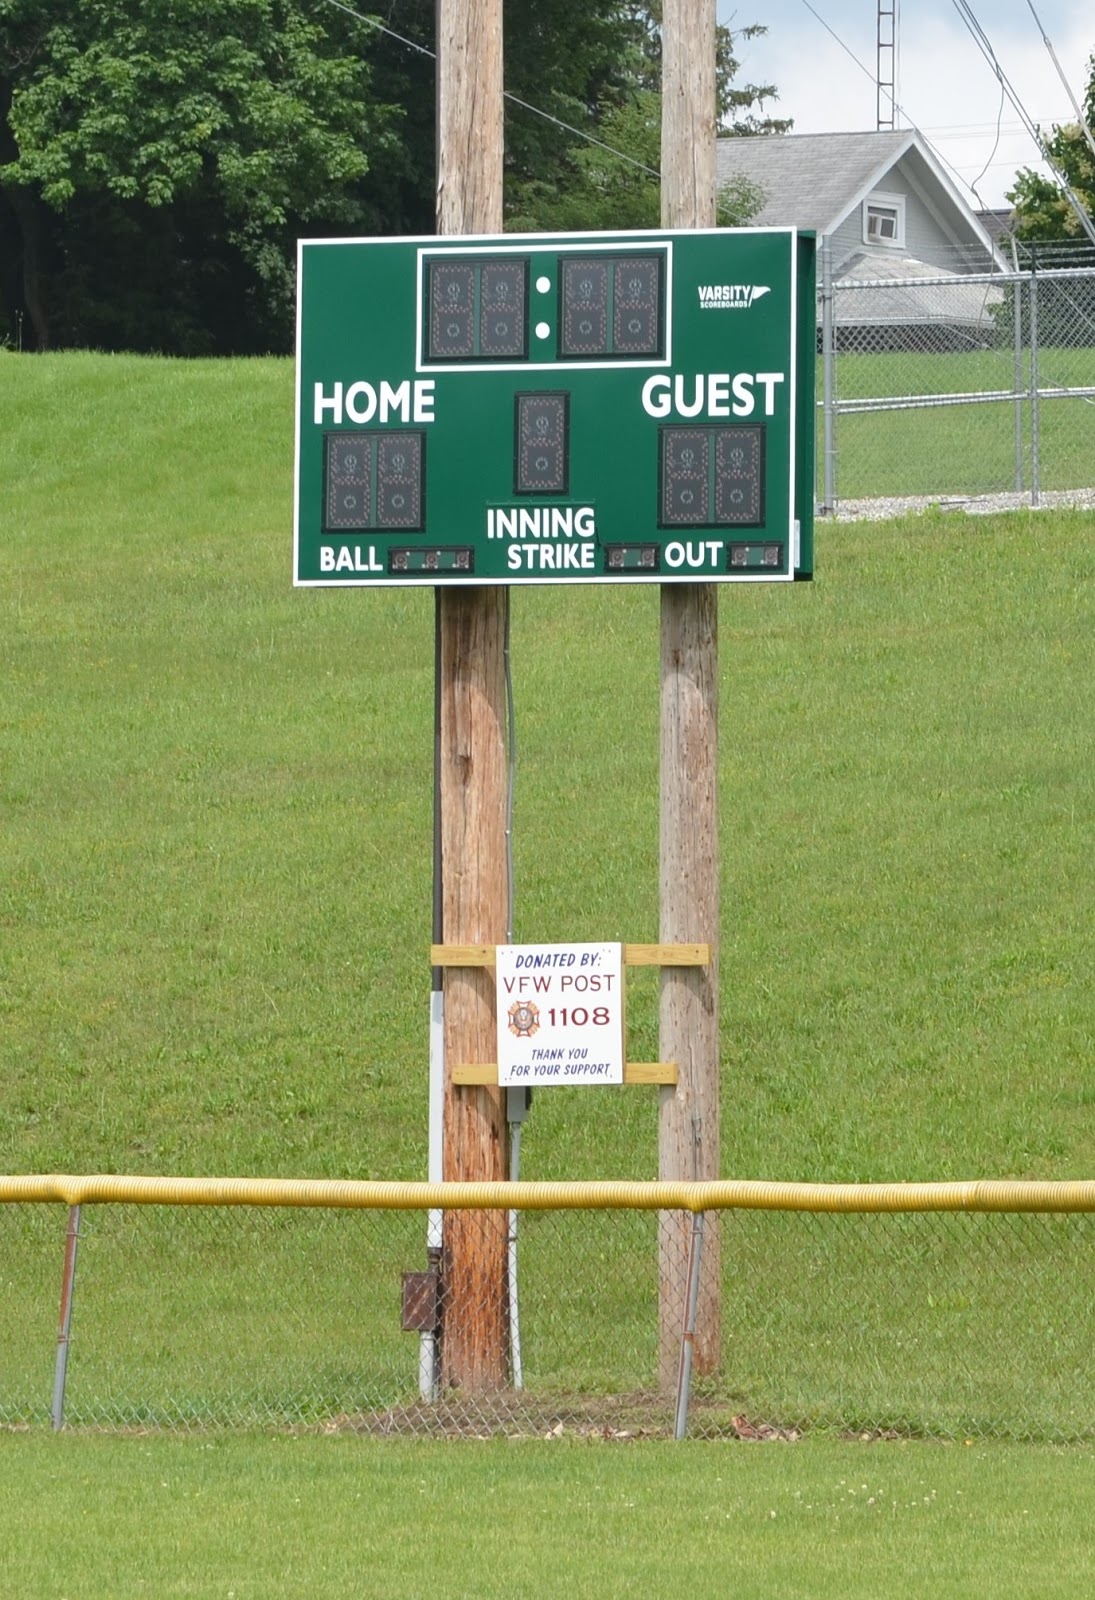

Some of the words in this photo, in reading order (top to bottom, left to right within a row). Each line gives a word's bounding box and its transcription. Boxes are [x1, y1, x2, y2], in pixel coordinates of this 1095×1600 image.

[698, 285, 751, 300] VARSITY
[700, 300, 748, 309] SCOREBOARDS
[314, 380, 435, 424] HOME
[641, 373, 784, 417] GUEST
[487, 508, 595, 539] INNING
[320, 546, 383, 571] BALL
[507, 543, 595, 569] STRIKE
[665, 541, 723, 567] OUT
[516, 953, 576, 968] DONATED
[580, 952, 602, 967] BY:
[503, 975, 552, 993] VFW
[561, 974, 615, 992] POST
[548, 1007, 610, 1026] 1108
[531, 1048, 565, 1060] THANK
[568, 1048, 588, 1060] YOU
[510, 1065, 531, 1076] FOR
[534, 1064, 561, 1076] YOUR
[564, 1063, 610, 1075] SUPPORT
